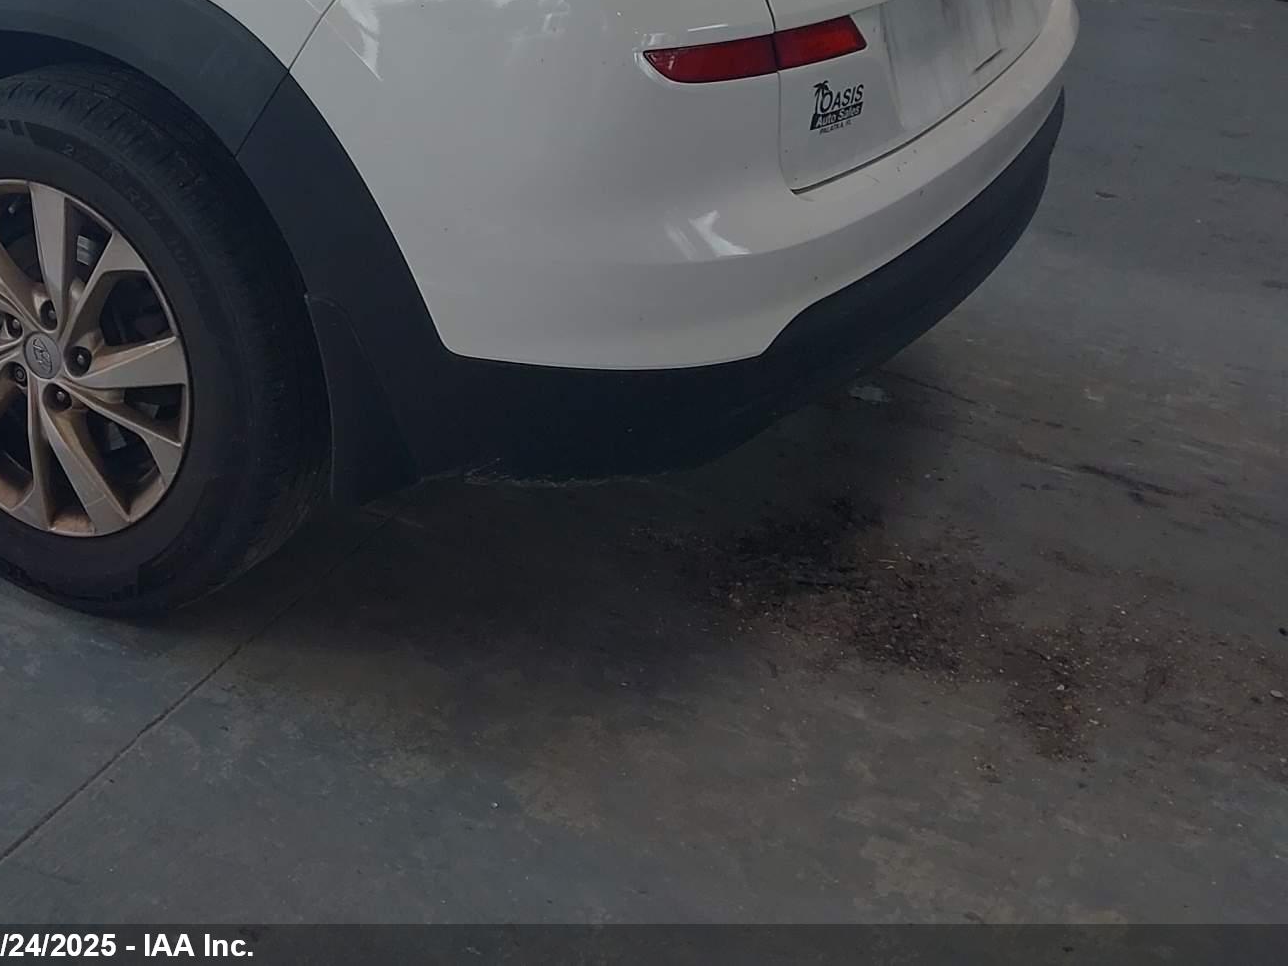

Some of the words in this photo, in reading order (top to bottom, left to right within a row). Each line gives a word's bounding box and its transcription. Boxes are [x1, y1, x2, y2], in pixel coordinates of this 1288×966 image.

[819, 83, 864, 114] OASIS
[816, 111, 841, 128] Auto
[840, 104, 860, 119] Sales
